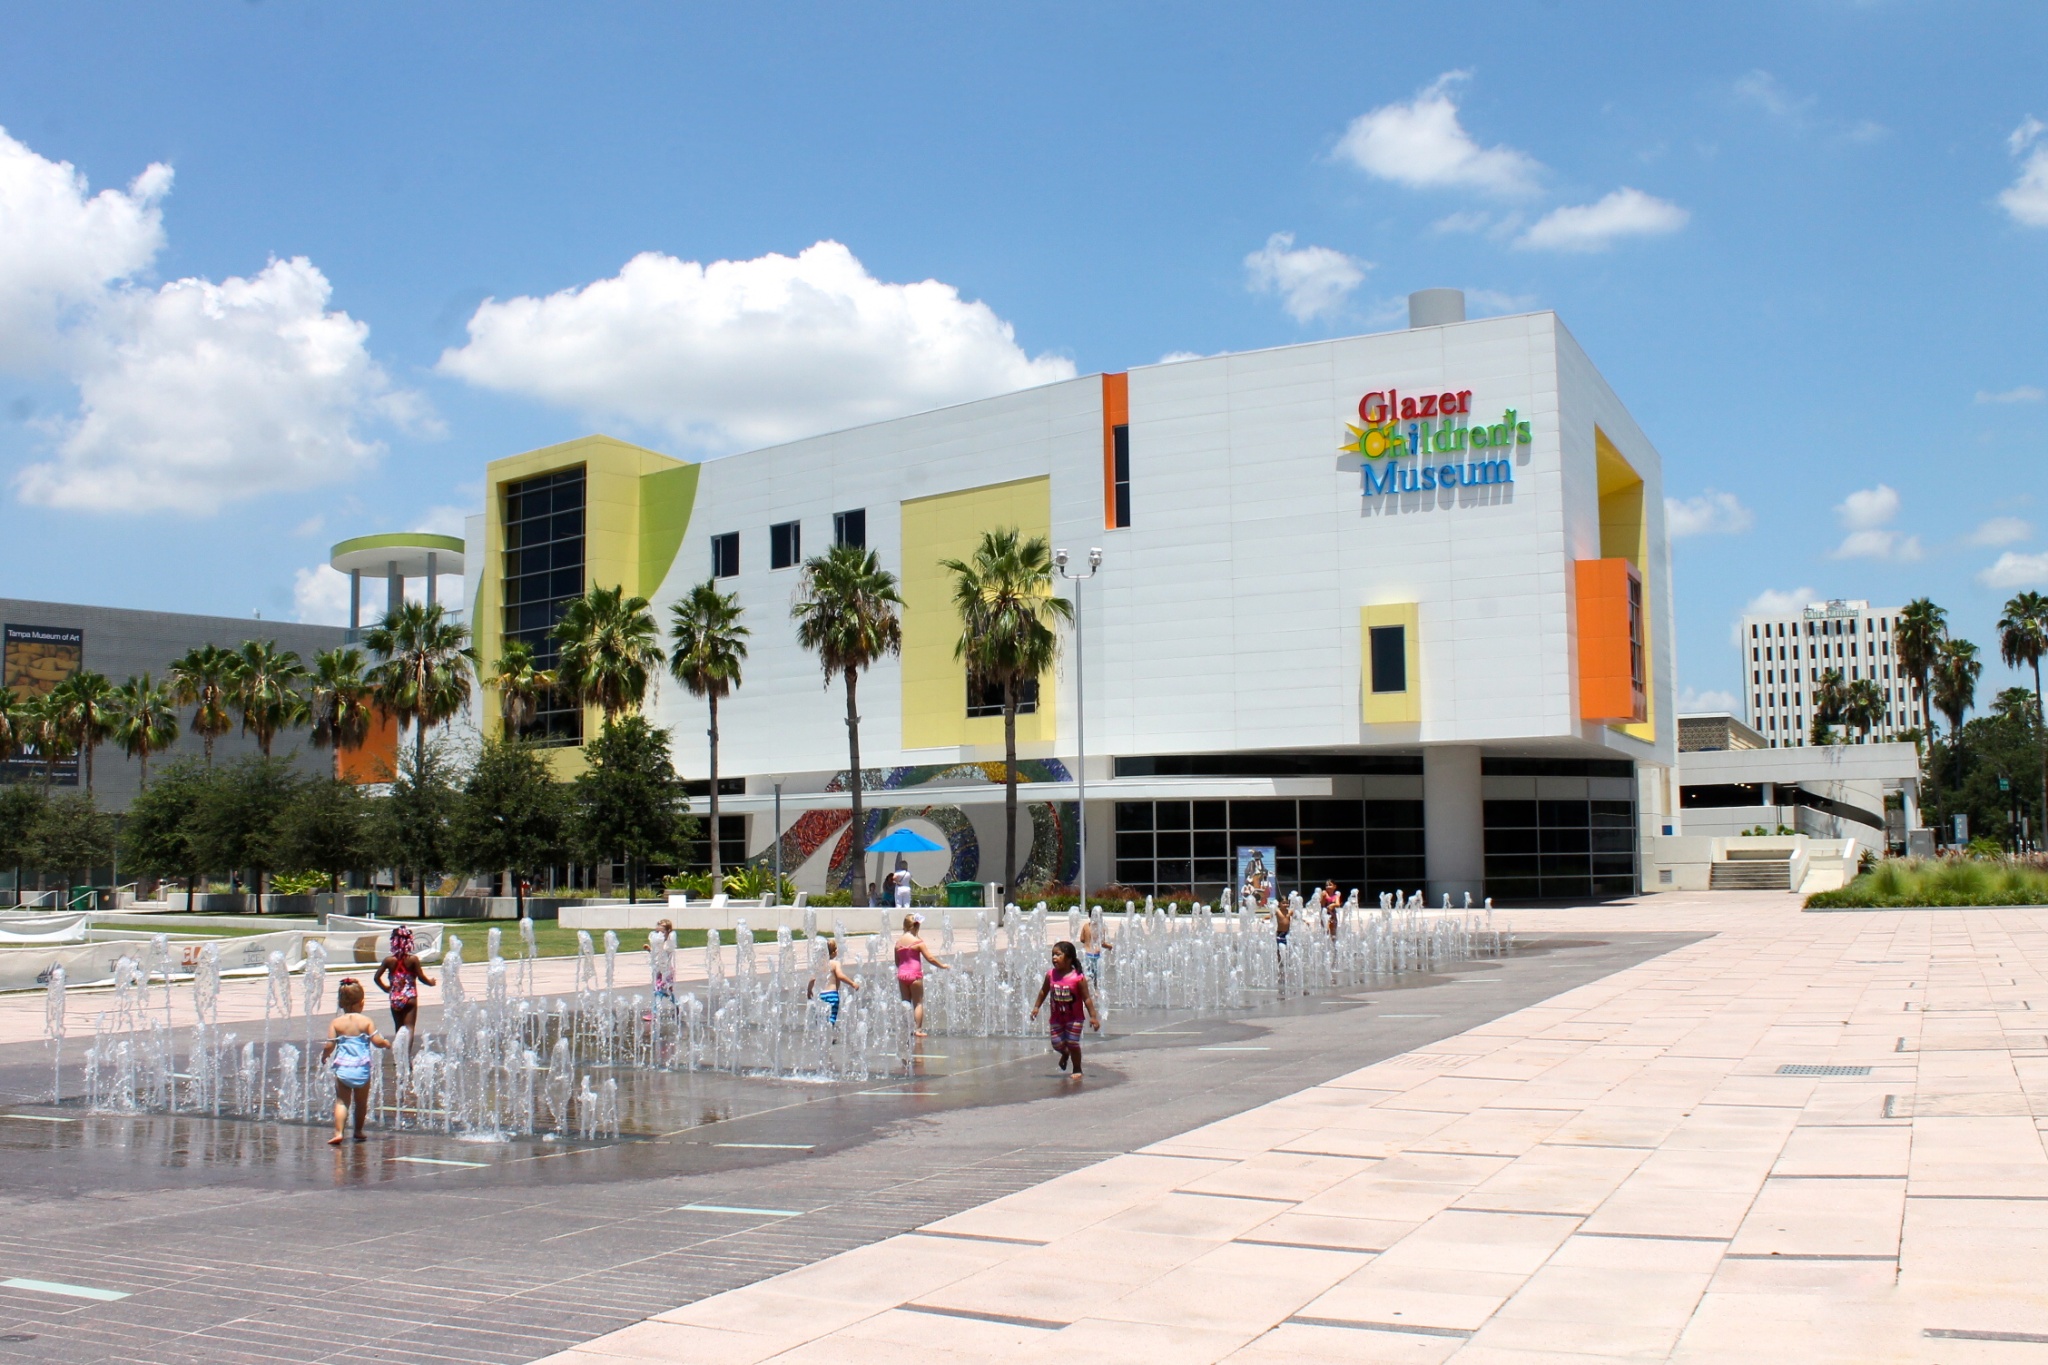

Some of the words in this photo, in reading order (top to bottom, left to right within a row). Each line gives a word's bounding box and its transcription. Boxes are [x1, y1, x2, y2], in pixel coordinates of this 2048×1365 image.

[1359, 389, 1472, 423] Glazer
[1360, 459, 1515, 497] Museum
[8, 629, 31, 639] Tampa
[32, 631, 61, 641] Museum
[62, 633, 69, 642] of
[69, 634, 80, 642] Art
